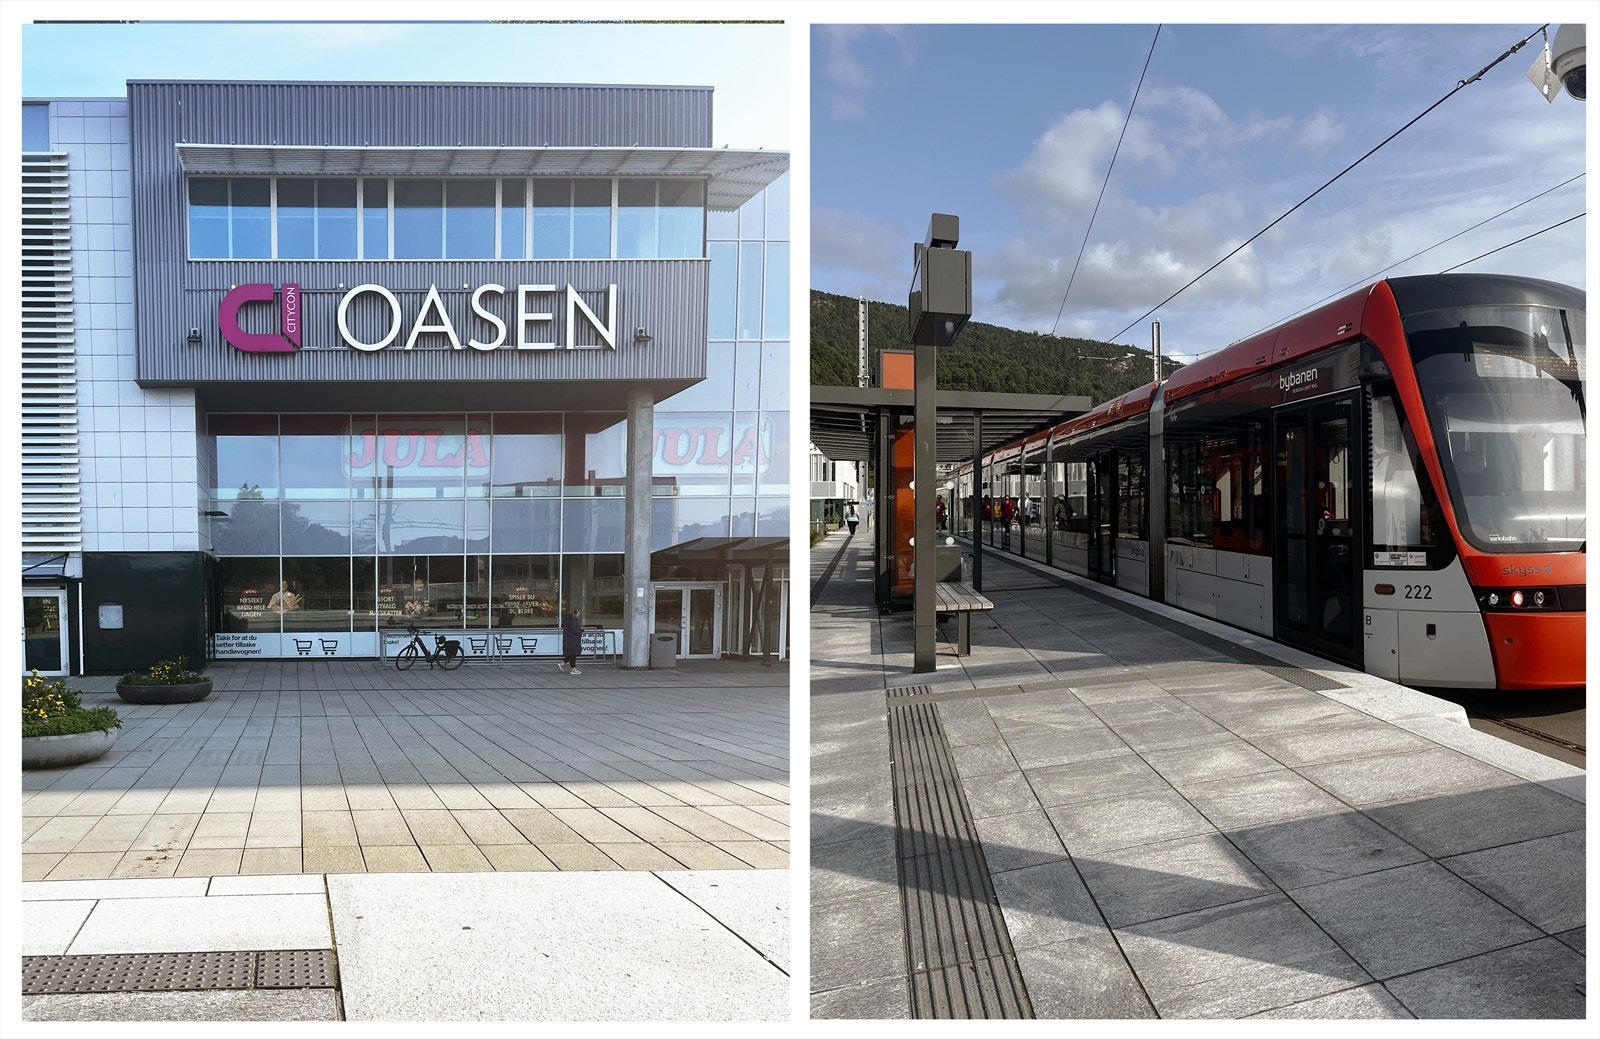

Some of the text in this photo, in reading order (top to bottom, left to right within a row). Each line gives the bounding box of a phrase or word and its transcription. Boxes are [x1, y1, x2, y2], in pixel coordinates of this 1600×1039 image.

[286, 287, 297, 333] CITYCON
[337, 282, 618, 352] OASEN
[1279, 368, 1318, 391] bybanen
[346, 429, 491, 469] JULA
[1503, 564, 1542, 577] skyss
[1404, 584, 1433, 600] 222
[1365, 615, 1373, 625] B
[215, 648, 262, 656] handlevognen!
